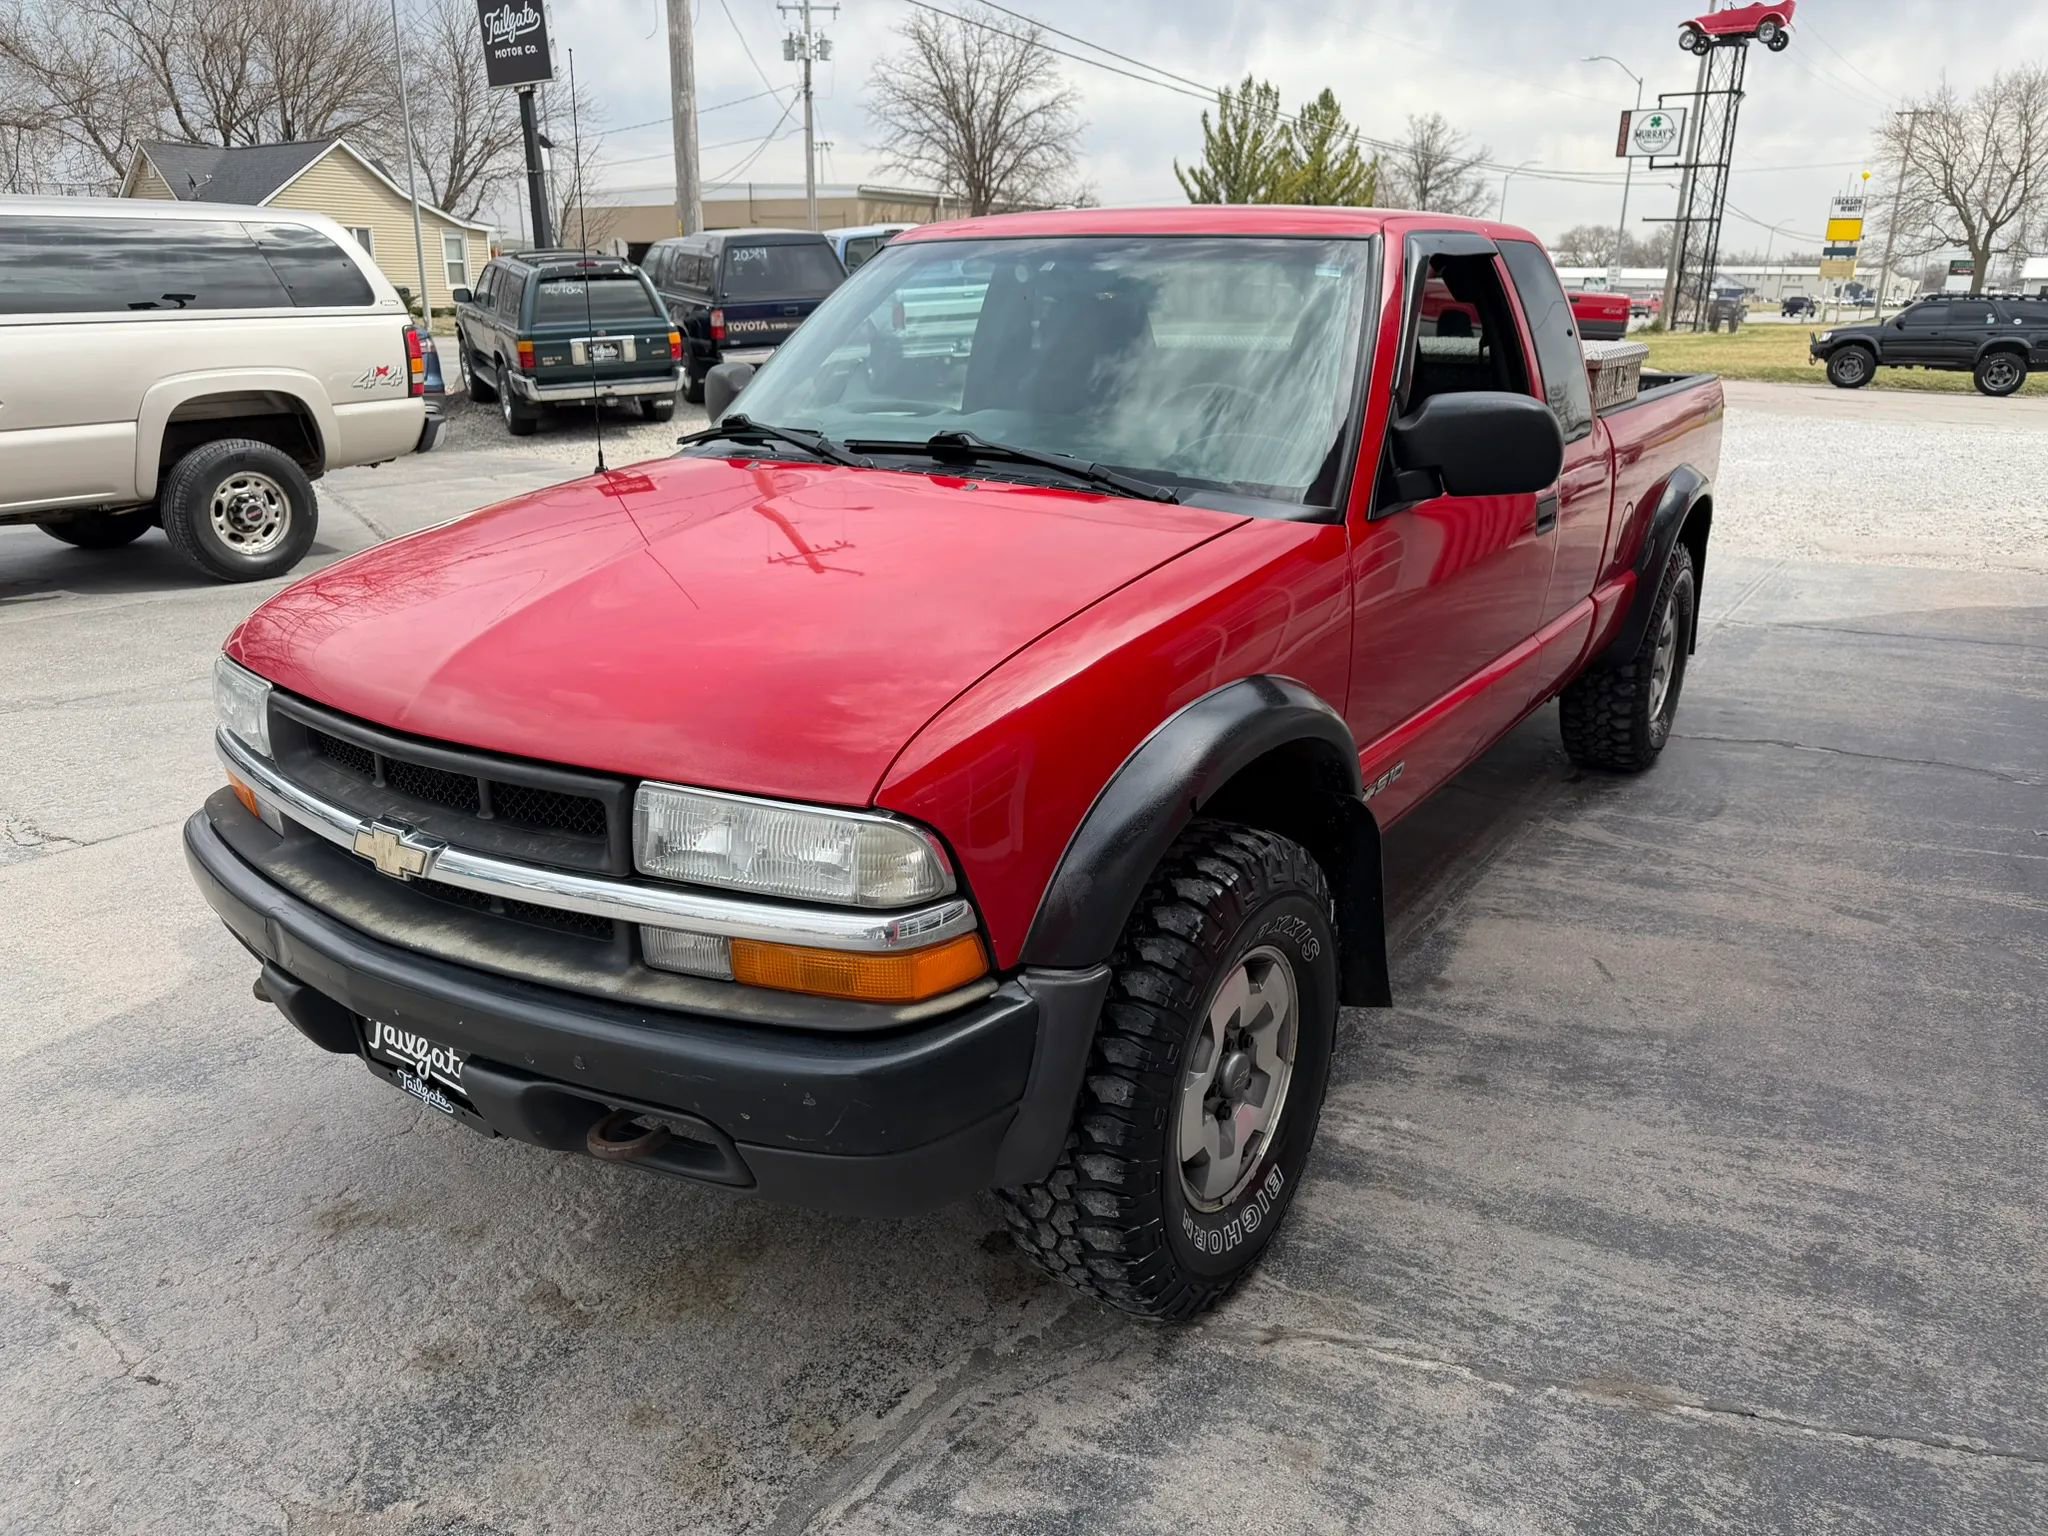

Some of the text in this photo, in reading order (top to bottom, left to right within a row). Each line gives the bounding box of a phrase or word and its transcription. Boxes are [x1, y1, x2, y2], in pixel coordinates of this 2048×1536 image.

[484, 1, 540, 45] Tailgate
[495, 45, 538, 59] MOTOR CO.
[1634, 128, 1677, 141] MURRAY'S
[727, 321, 769, 332] TOYOTA
[397, 1069, 454, 1113] Tailgate
[1182, 1163, 1284, 1255] BIGHORN
